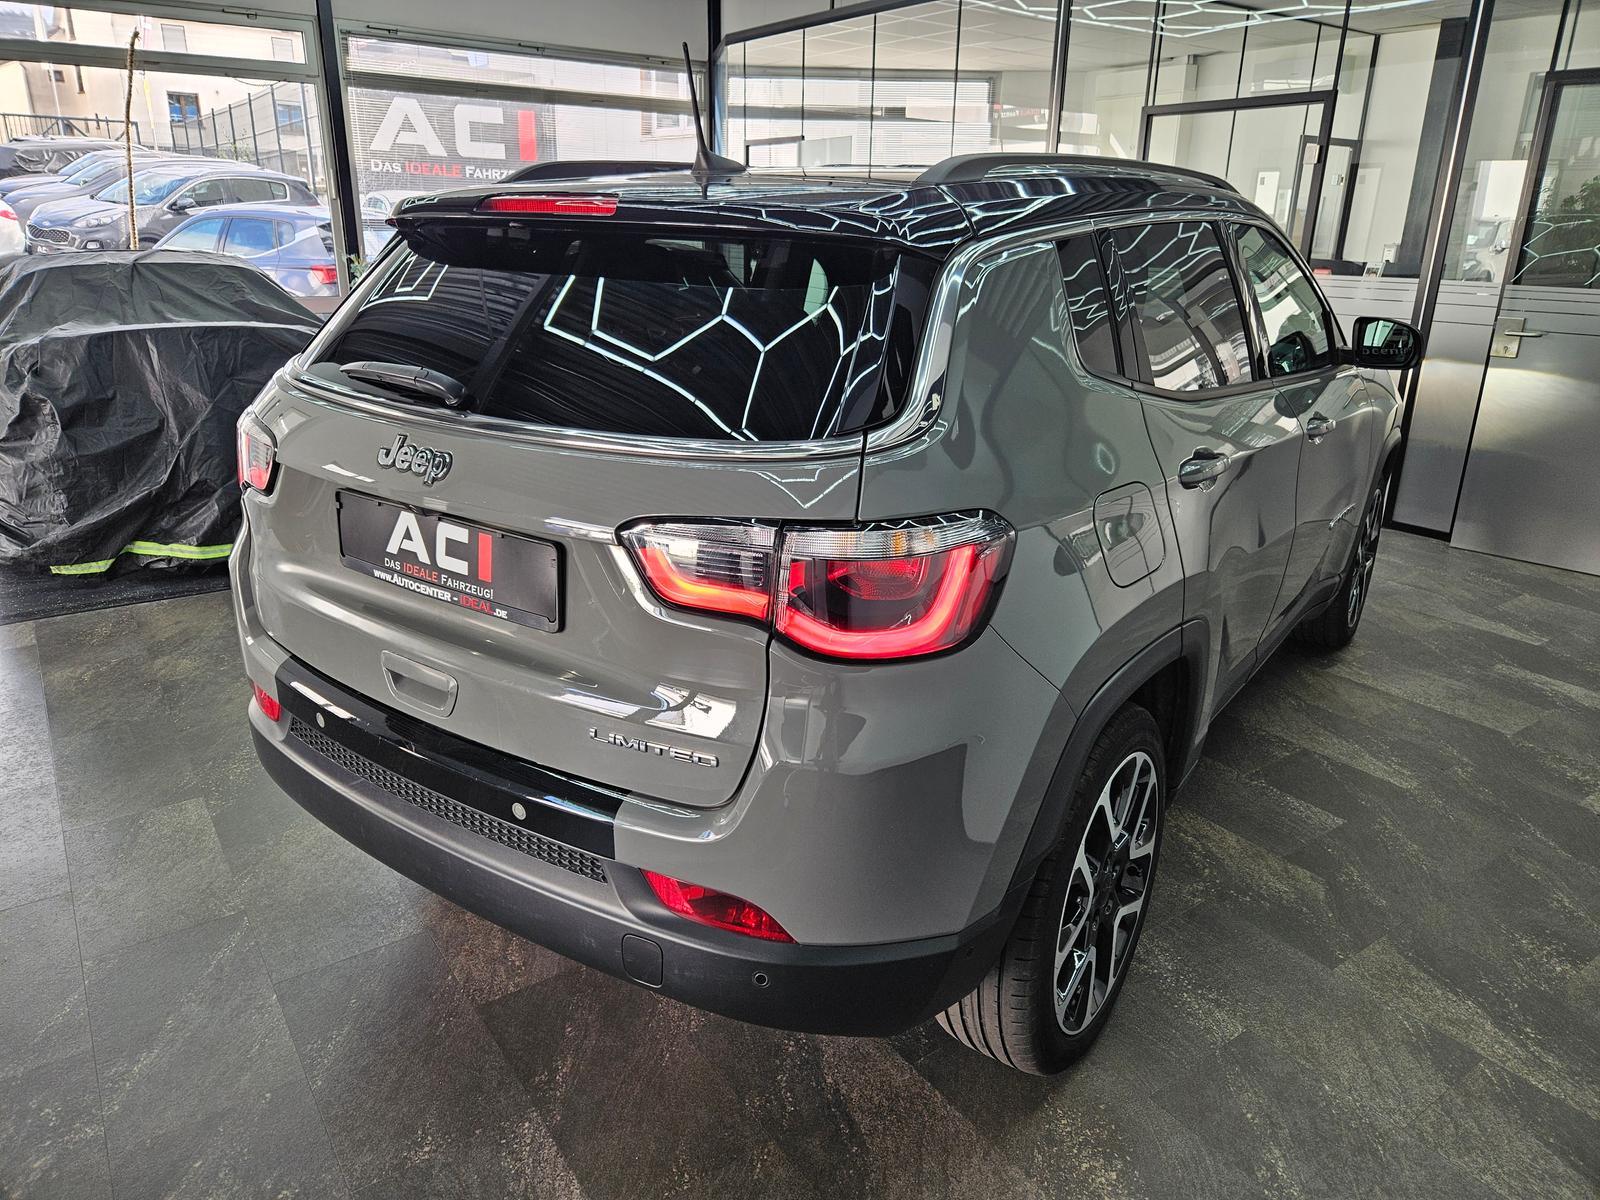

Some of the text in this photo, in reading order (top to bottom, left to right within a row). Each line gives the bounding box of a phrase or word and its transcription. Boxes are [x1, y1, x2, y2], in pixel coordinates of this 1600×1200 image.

[371, 160, 402, 173] DAS
[405, 161, 463, 178] IDEALE
[377, 433, 453, 487] Jeep
[386, 511, 492, 583] ACI
[384, 557, 494, 600] DAS IDEALE FAHRZEUG!
[589, 726, 719, 767] LIMITED
